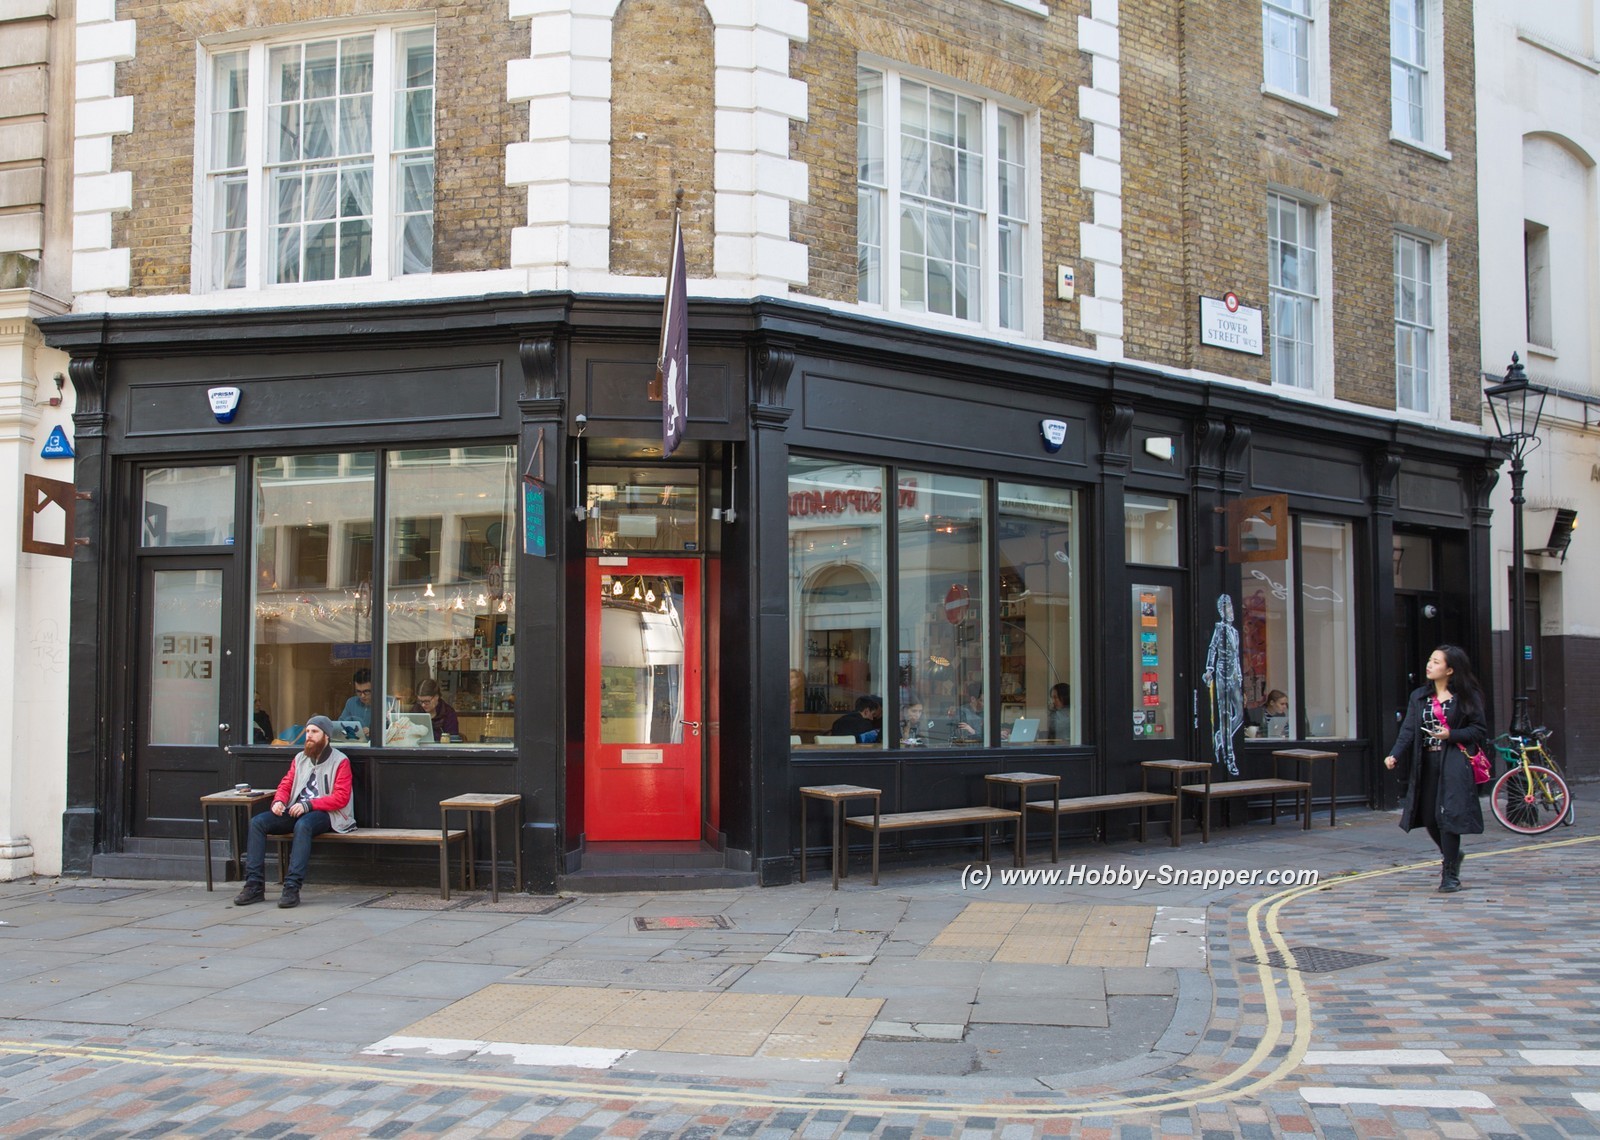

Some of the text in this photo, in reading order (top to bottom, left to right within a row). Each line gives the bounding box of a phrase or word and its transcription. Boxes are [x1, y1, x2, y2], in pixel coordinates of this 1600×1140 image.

[1217, 319, 1248, 334] TOWER
[1208, 329, 1257, 348] STREET WC2
[1590, 463, 1600, 483] A
